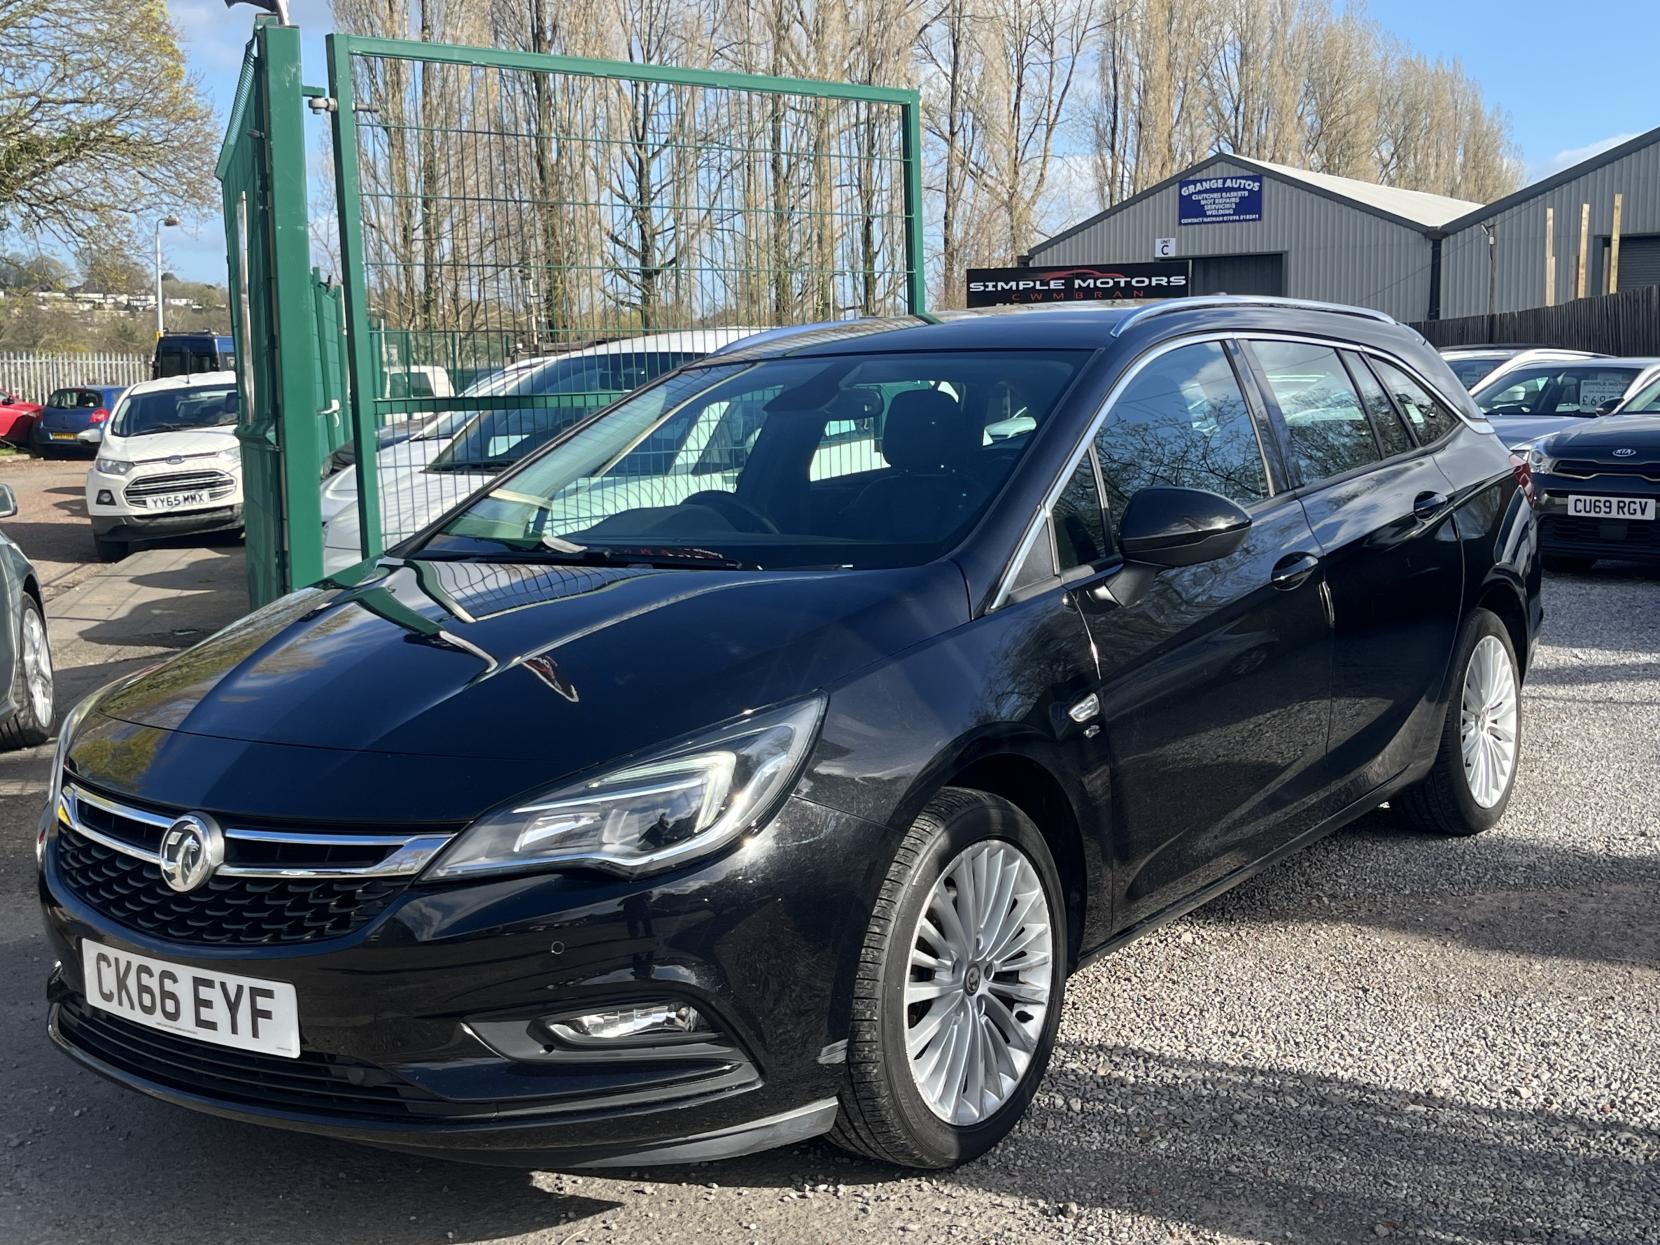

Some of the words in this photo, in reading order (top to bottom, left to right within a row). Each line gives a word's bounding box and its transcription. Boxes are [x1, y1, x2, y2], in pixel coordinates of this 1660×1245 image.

[1181, 179, 1223, 196] GRANGE
[1224, 179, 1260, 191] AUTOS
[1161, 244, 1169, 256] C
[969, 280, 1065, 292] SIMPLE
[1074, 276, 1186, 289] MOTORS
[1012, 290, 1144, 302] CWMBRAN
[152, 495, 181, 508] YY65
[183, 493, 205, 505] MMX
[1574, 498, 1612, 514] CU69
[1616, 500, 1648, 516] RGV
[96, 952, 181, 1022] CK66
[192, 976, 275, 1039] EYF
